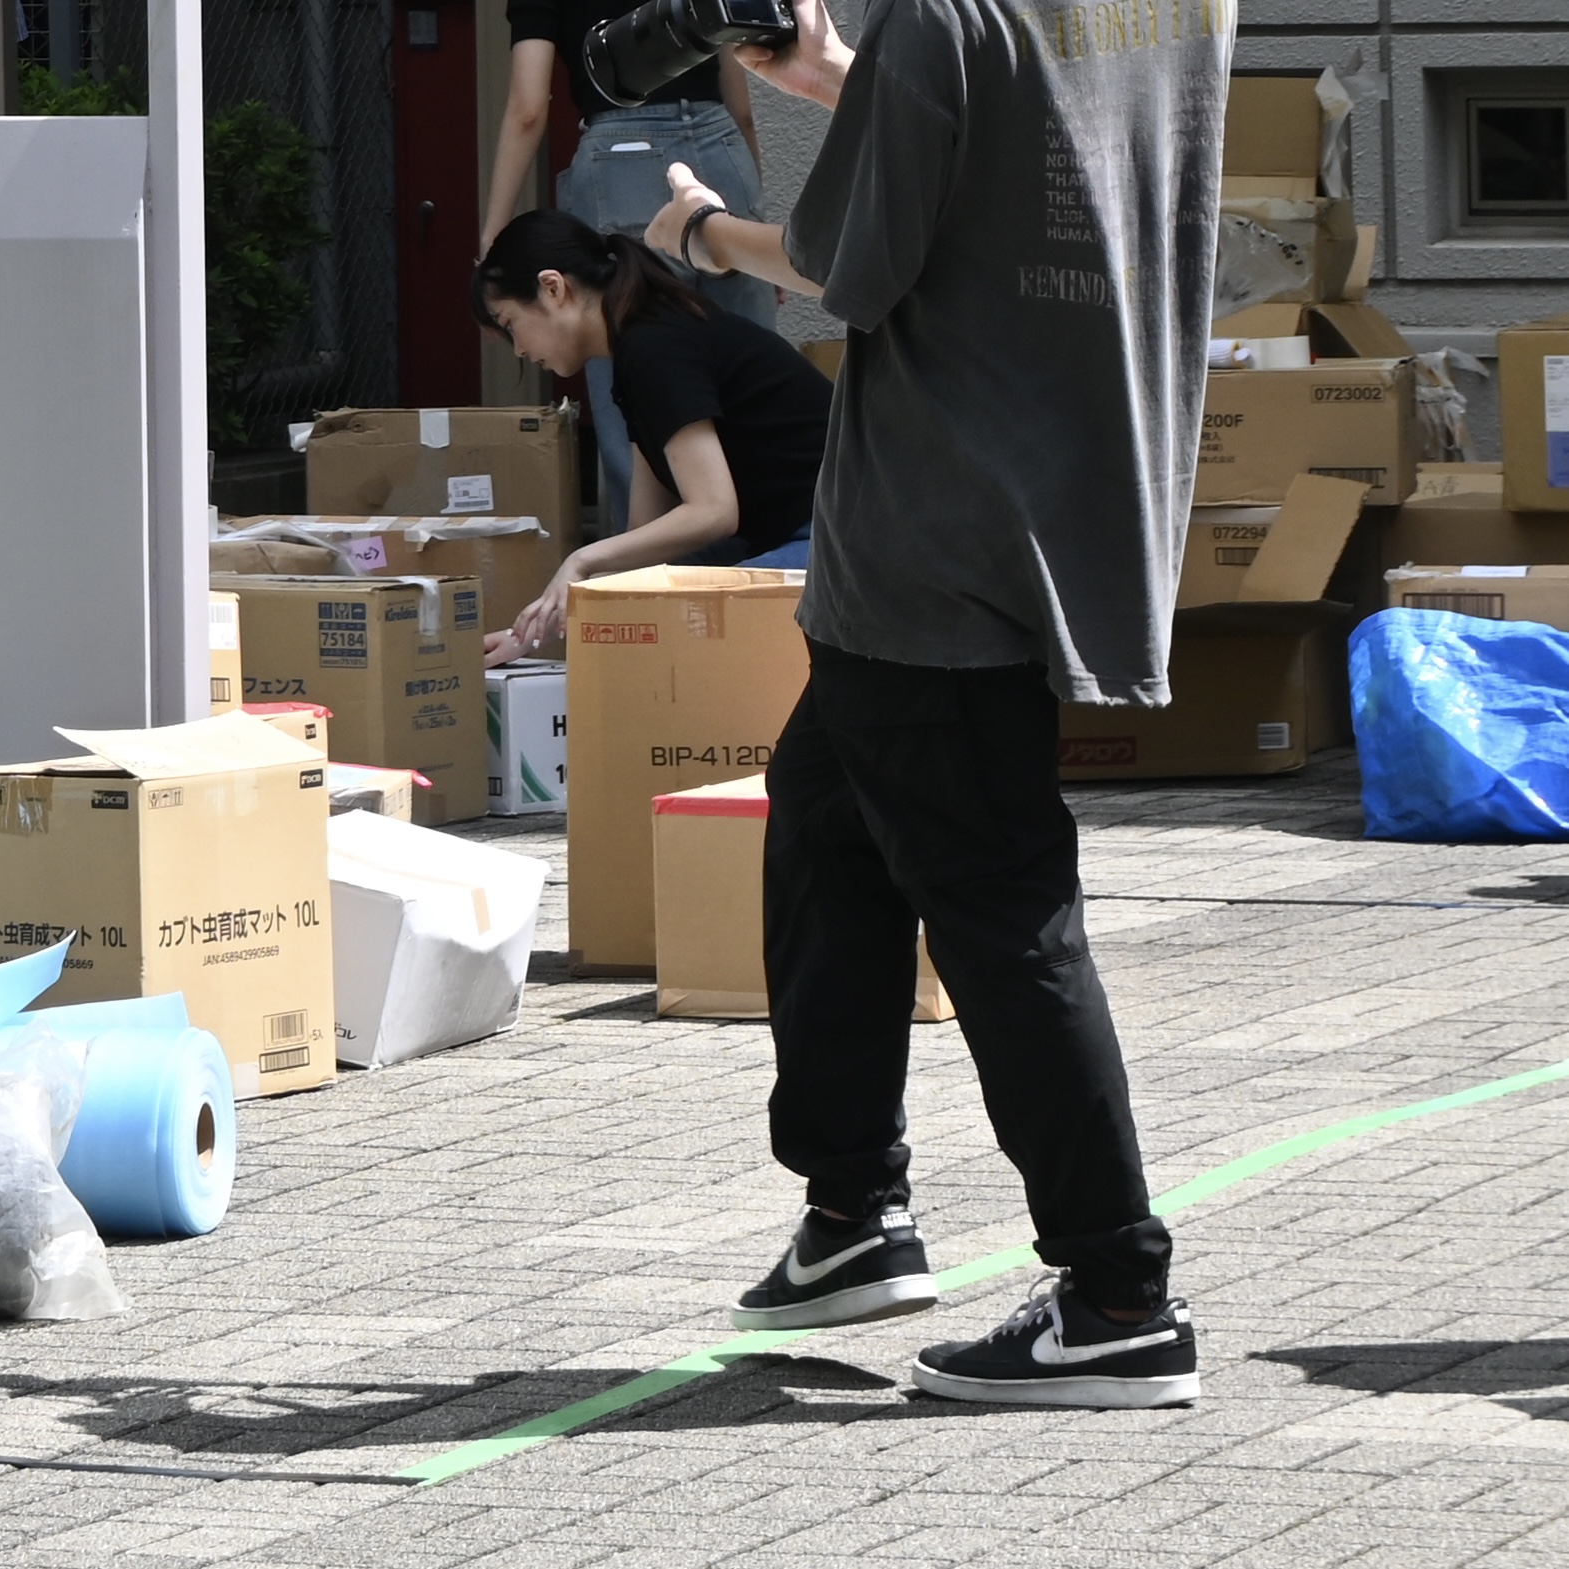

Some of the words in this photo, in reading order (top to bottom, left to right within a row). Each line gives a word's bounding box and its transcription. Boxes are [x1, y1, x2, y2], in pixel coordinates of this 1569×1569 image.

[1315, 387, 1382, 401] 0723002
[1203, 414, 1244, 428] 200F
[321, 632, 364, 647] 75184
[651, 745, 773, 767] BIP-412D
[158, 903, 287, 949] カブト虫育成マット
[293, 899, 320, 929] 10L
[100, 926, 128, 949] 10L
